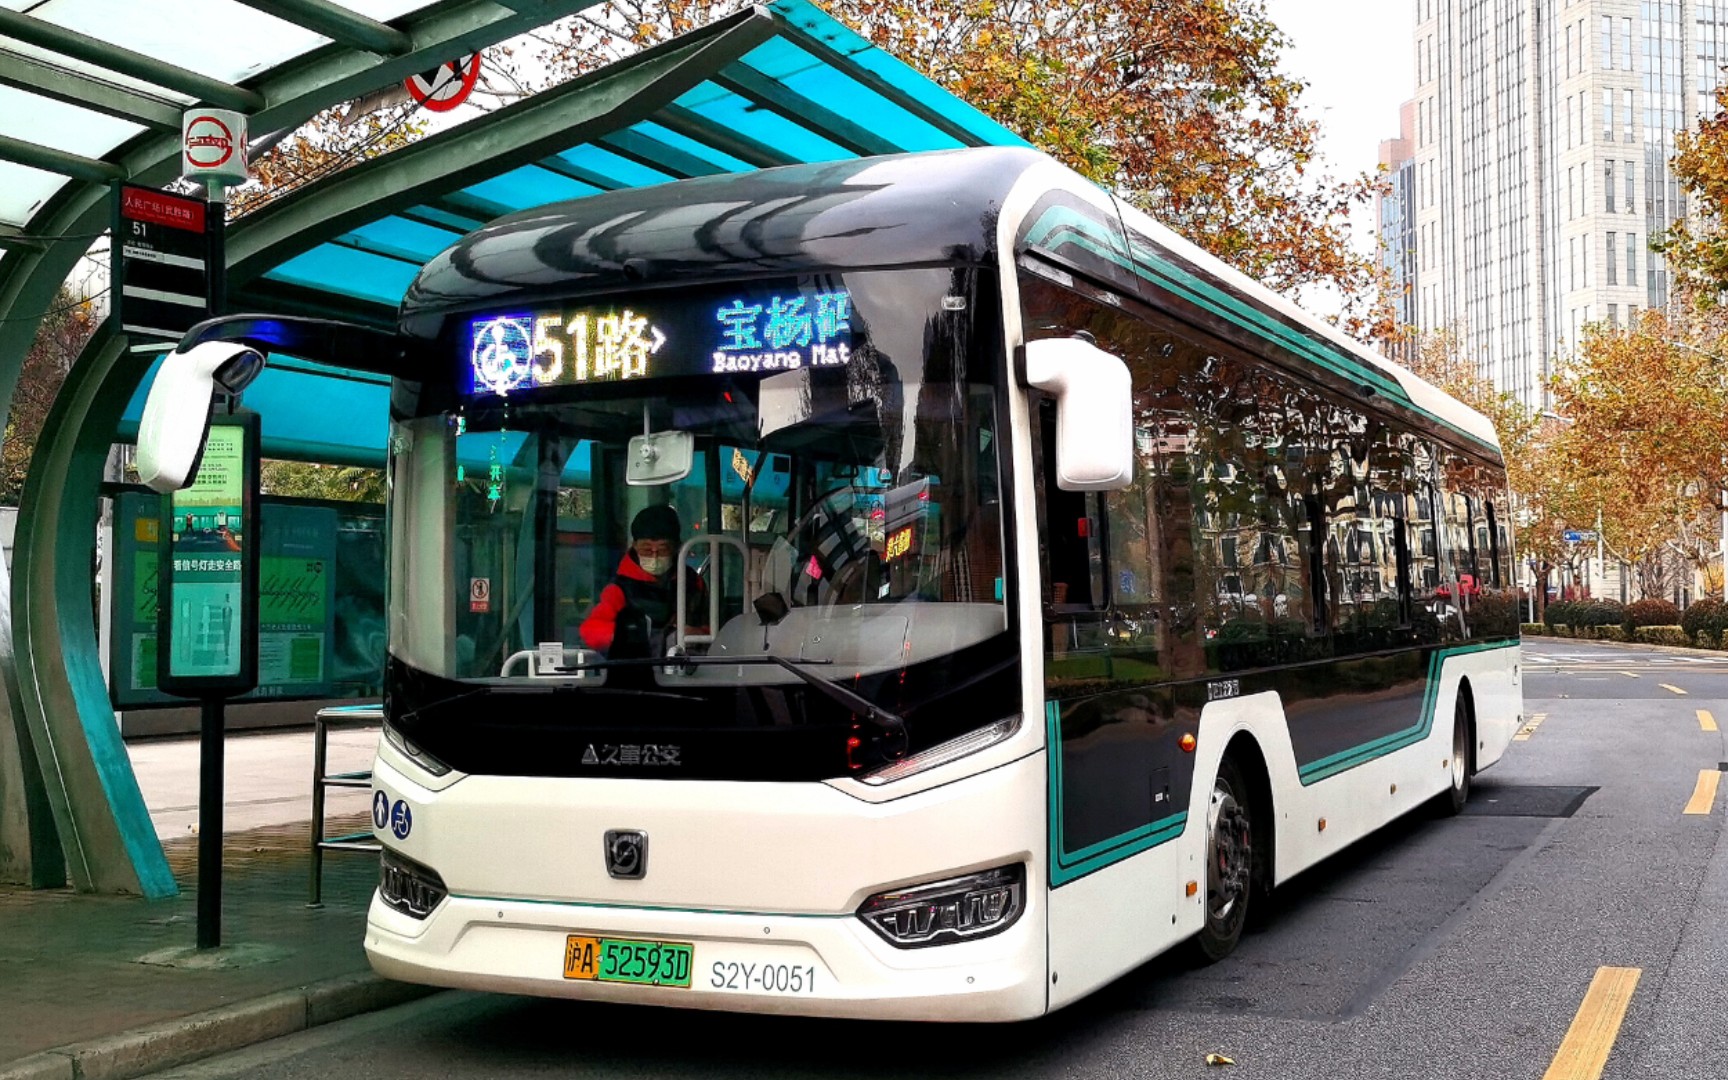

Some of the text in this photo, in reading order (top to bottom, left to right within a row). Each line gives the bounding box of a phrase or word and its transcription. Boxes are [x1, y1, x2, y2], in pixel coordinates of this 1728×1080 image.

[132, 221, 147, 237] 51
[532, 310, 652, 384] 51路
[712, 343, 851, 373] Baoyang Mat
[566, 942, 691, 980] 沪A 52593D
[710, 961, 816, 993] S2Y-0051
